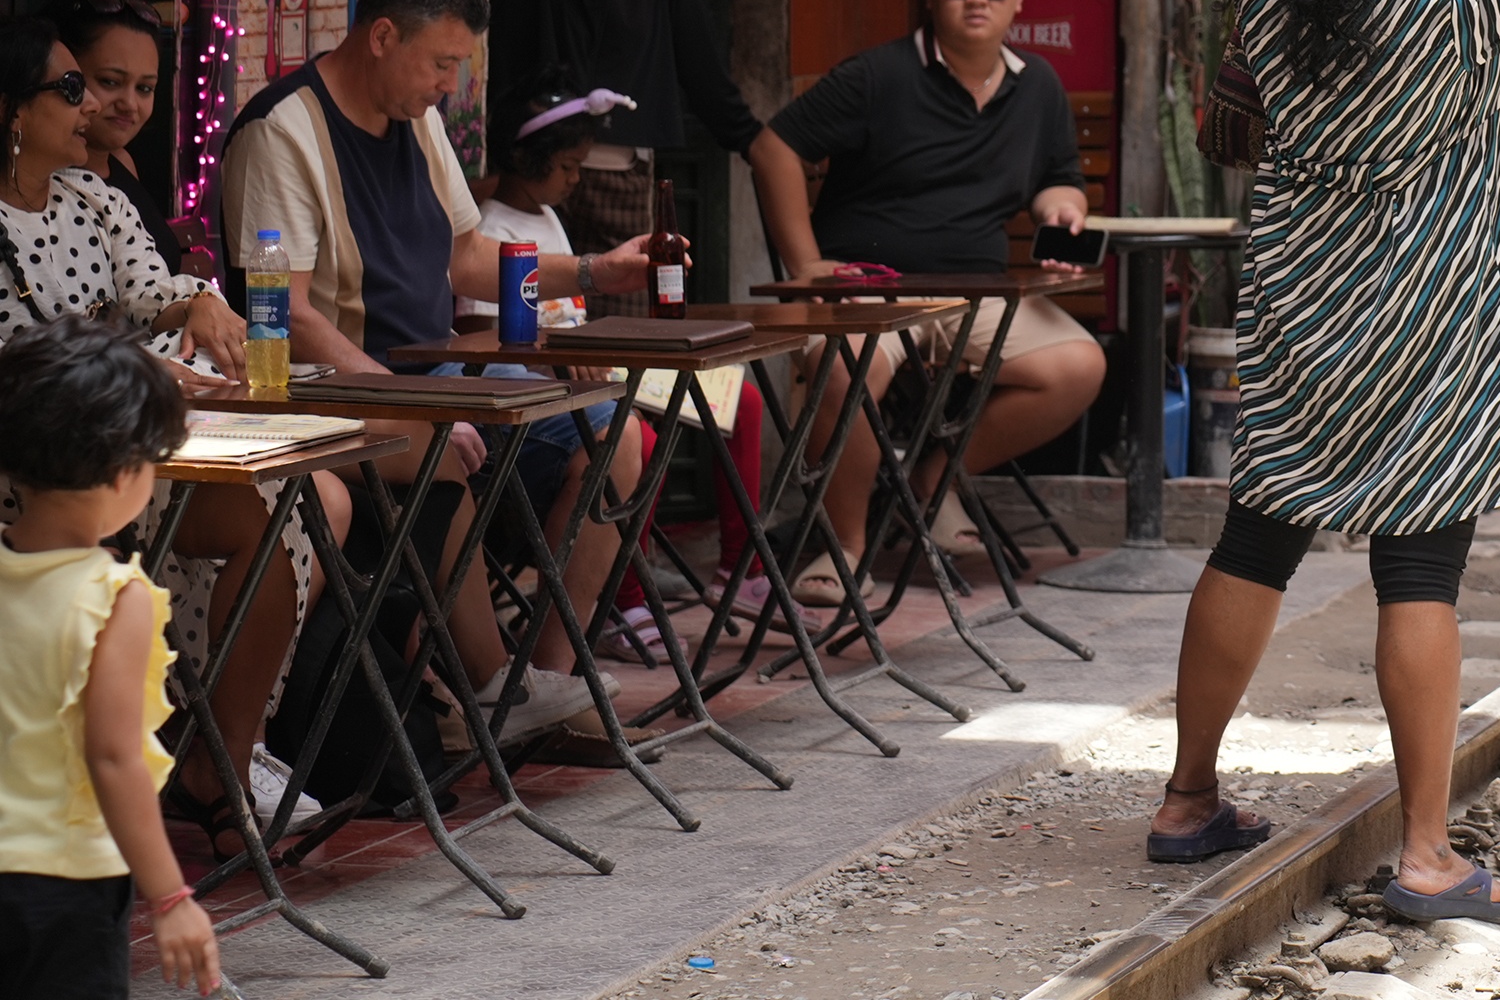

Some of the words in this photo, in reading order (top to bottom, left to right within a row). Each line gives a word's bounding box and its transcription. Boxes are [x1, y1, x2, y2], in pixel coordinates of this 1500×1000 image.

[1004, 22, 1031, 45] NOI
[1034, 21, 1072, 49] BEER
[523, 285, 538, 294] PE
